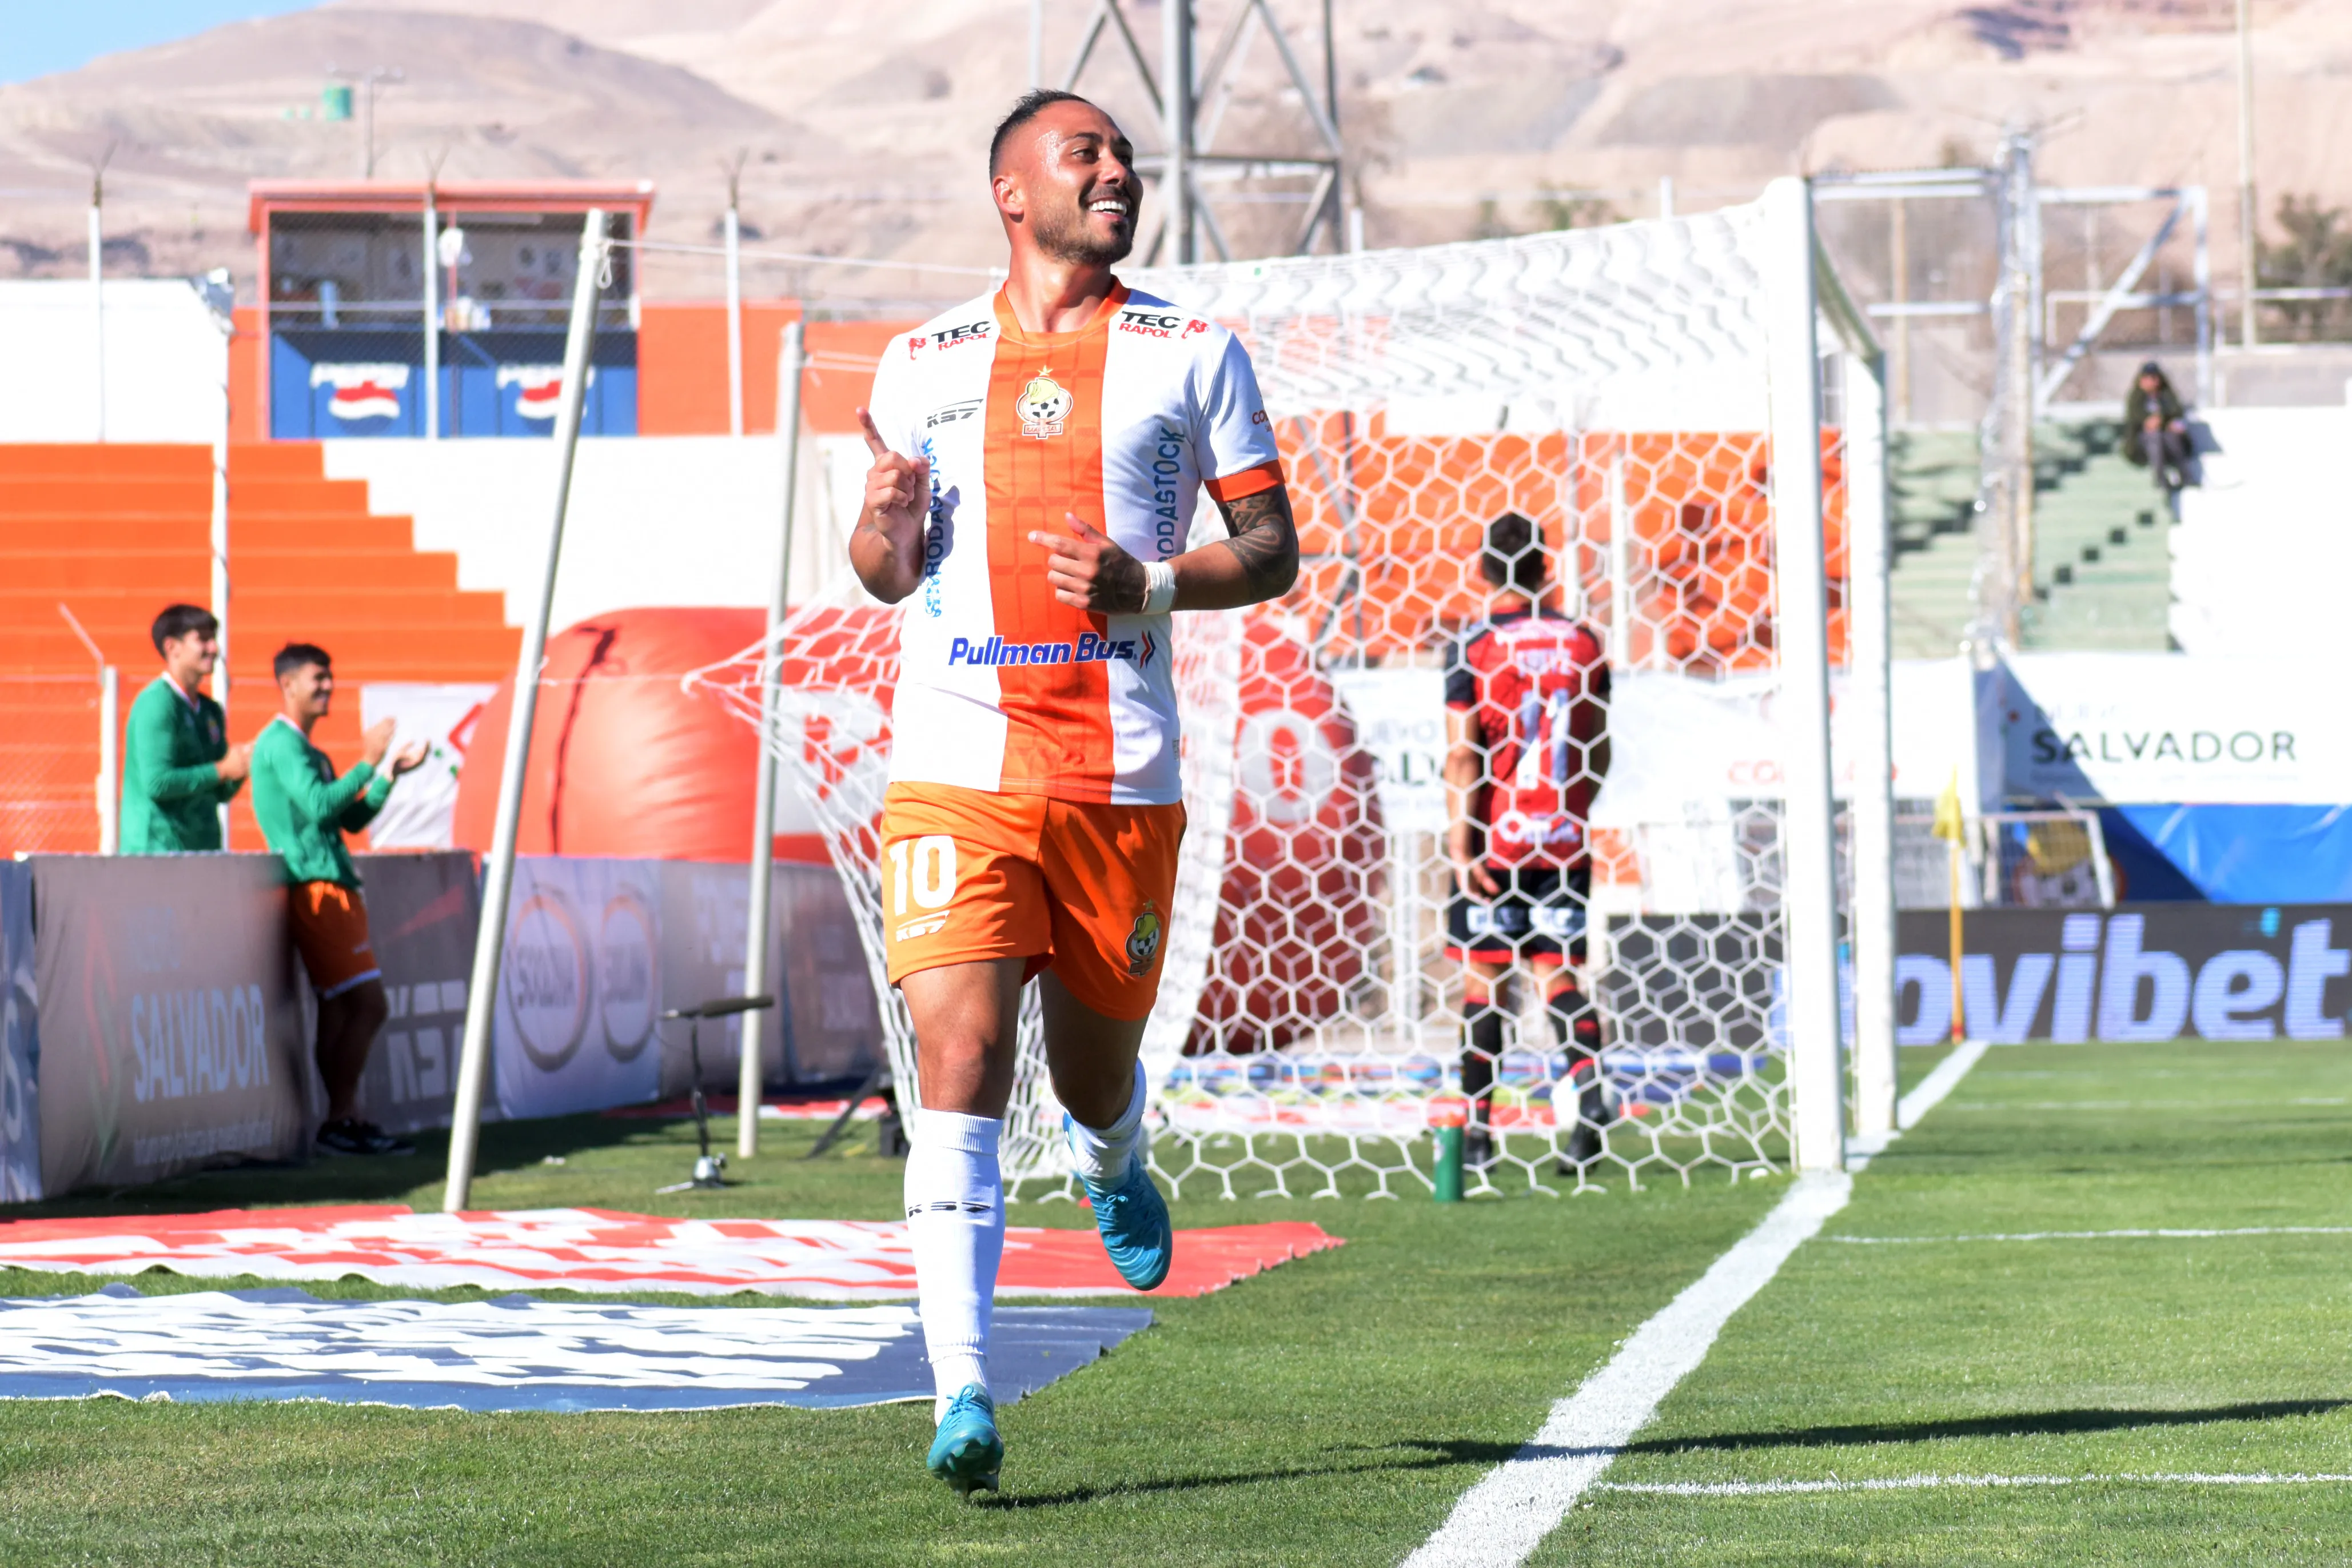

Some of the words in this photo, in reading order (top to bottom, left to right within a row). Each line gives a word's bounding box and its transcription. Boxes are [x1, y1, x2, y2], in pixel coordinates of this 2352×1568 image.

[931, 321, 991, 343] TEC
[1119, 323, 1171, 338] RAPOL
[1122, 310, 1181, 329] TEC
[938, 333, 992, 351] RAPOL
[948, 635, 1072, 666] Pullman
[2031, 729, 2298, 764] SALVADOR
[888, 835, 957, 916] 10
[131, 982, 270, 1104] SALVADOR
